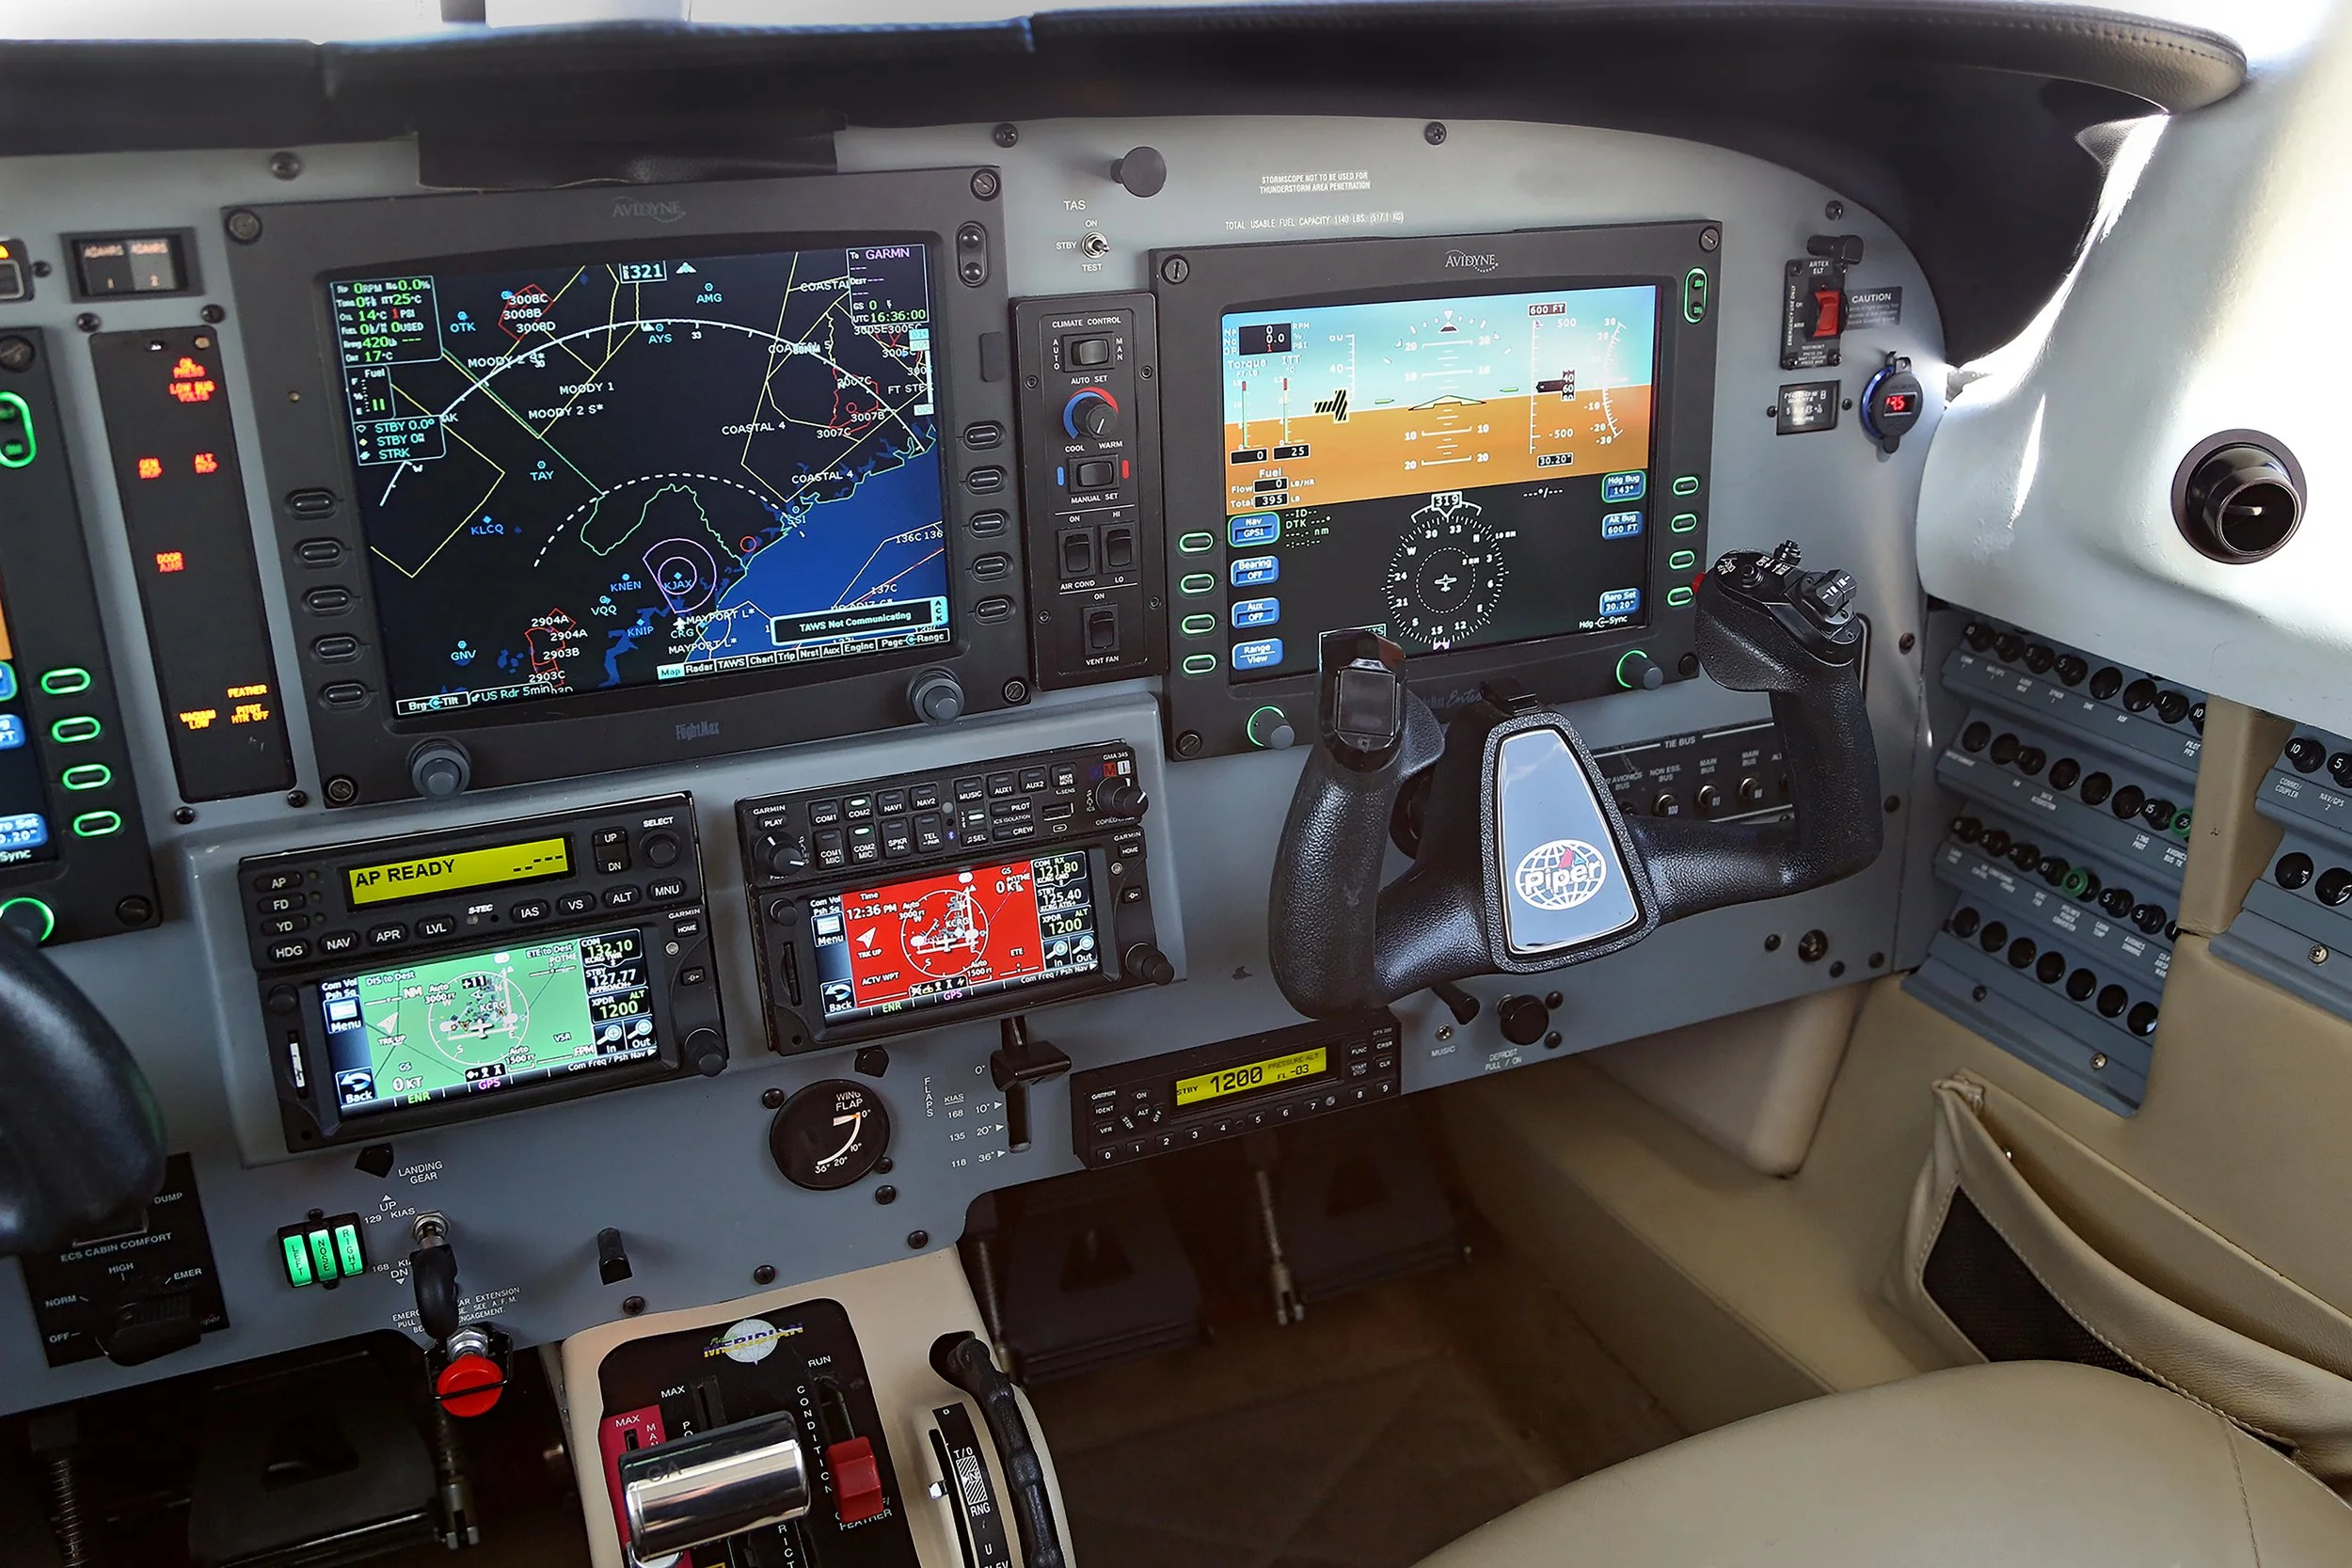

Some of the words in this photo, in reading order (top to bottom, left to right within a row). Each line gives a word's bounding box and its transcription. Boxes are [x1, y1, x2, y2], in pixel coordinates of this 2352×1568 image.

[1262, 174, 1304, 183] STORMSCOPE
[1306, 174, 1317, 182] NOT
[1319, 173, 1327, 182] TO
[1329, 173, 1337, 182] BE
[1338, 172, 1354, 181] USED
[1356, 171, 1367, 180] FOR
[1260, 184, 1311, 194] THUNDERSTORM
[1312, 183, 1328, 192] AREA
[1329, 181, 1371, 190] PENETRATION
[1064, 200, 1086, 211] TAS
[1085, 219, 1097, 228] ON
[1226, 221, 1245, 230] TOTAL
[1251, 219, 1275, 229] USABLE
[1279, 218, 1295, 227] FUEL
[1299, 216, 1329, 226] CAPACITY
[1334, 215, 1348, 224] 1140
[1370, 213, 1389, 223] (517.1
[1393, 211, 1404, 223] KG)
[1056, 241, 1077, 250] STBY
[866, 248, 910, 260] GARMN
[1445, 254, 1496, 268] AVIDYNE
[630, 264, 663, 278] 321
[1082, 263, 1103, 272] TEST
[696, 293, 723, 303] AMG
[1851, 293, 1892, 303] CAUTION
[1530, 305, 1548, 314] 600
[1552, 304, 1564, 312] FT
[871, 309, 926, 323] 16:36:00
[451, 323, 475, 333] OTK
[1052, 319, 1083, 328] CLIMATE
[1088, 317, 1121, 325] CONTROL
[1071, 376, 1089, 385] AUTO
[560, 383, 604, 394] MOODY
[608, 382, 613, 391] 1
[1099, 440, 1123, 450] WARM
[378, 450, 410, 459] STRK
[1292, 447, 1305, 456] 25
[530, 471, 554, 481] TAY
[1260, 468, 1282, 478] Fuel
[1626, 475, 1640, 483] Bug
[1071, 495, 1101, 503] MANUAL
[1262, 496, 1283, 504] 395
[1436, 497, 1458, 506] 319
[1246, 517, 1263, 526] Nav
[470, 524, 504, 535] KLCQ
[1238, 559, 1272, 570] Bearing
[1248, 571, 1263, 579] OFF
[611, 581, 642, 592] KNEN
[1060, 582, 1073, 591] AIR
[591, 605, 617, 616] VQQ
[800, 622, 826, 632] TAWS
[829, 619, 844, 628] Not
[846, 610, 912, 626] Communicating
[660, 667, 681, 677] Map
[685, 662, 713, 673] Radar
[718, 658, 745, 669] TAWS
[750, 655, 773, 665] Chart
[778, 652, 795, 662] Trip
[801, 648, 819, 658] Nrst
[823, 645, 840, 656] Aux
[844, 641, 874, 654] Engine
[1086, 657, 1104, 666] VENT
[228, 684, 267, 699] FEATHER
[1665, 738, 1677, 749] TIE
[1678, 736, 1695, 746] BUS
[2275, 785, 2299, 799] COUPLER
[917, 799, 935, 807] NAV2
[1011, 802, 1030, 811] PILOT
[753, 805, 786, 815] GARMIN
[849, 809, 870, 817] COM2
[644, 816, 674, 828] SELECT
[765, 818, 783, 827] PLAY
[815, 815, 836, 823] COM1
[1013, 827, 1033, 835] CREW
[605, 833, 617, 842] UP
[609, 862, 621, 871] DN
[1040, 862, 1078, 877] 121.80
[355, 873, 381, 887] AP
[388, 859, 455, 882] READY
[1524, 861, 1601, 895] Piper
[271, 878, 286, 889] AP
[655, 884, 679, 896] MNU
[612, 892, 631, 904] ALT
[1042, 889, 1082, 905] 125.40
[274, 900, 289, 911] FD
[521, 907, 539, 917] IAS
[669, 909, 700, 919] GARMIN
[847, 905, 882, 921] 12:36
[883, 904, 898, 913] PM
[426, 923, 447, 934] LVL
[1049, 919, 1082, 935] 1200
[376, 929, 400, 942] APR
[326, 938, 350, 950] NAV
[588, 939, 633, 956] 132.10
[276, 945, 303, 958] HDG
[592, 968, 636, 986] 127.77
[943, 990, 962, 1001] GPS
[829, 1001, 852, 1012] Back
[1376, 1041, 1392, 1050] CRSR
[1431, 1046, 1455, 1057] MUSIC
[1290, 1065, 1310, 1076] -03
[1176, 1085, 1198, 1096] STBY
[1210, 1067, 1263, 1094] 1200
[835, 1091, 861, 1101] WING
[924, 1077, 933, 1117] FLAPS
[945, 1094, 964, 1103] KIAS
[1136, 1091, 1147, 1100] ON
[835, 1099, 863, 1111] FLAP
[947, 1110, 963, 1119] 168
[949, 1132, 965, 1141] 135
[398, 1161, 442, 1177] LANDING
[410, 1172, 437, 1184] GEAR
[154, 1193, 183, 1204] DUMP
[379, 1201, 396, 1212] UP
[364, 1214, 381, 1224] 129
[390, 1208, 415, 1218] KIAS
[60, 1252, 82, 1261] ECS
[85, 1243, 118, 1257] CABIN
[120, 1233, 172, 1249] COMFORT
[342, 1229, 356, 1270] RIGHT
[291, 1244, 304, 1276] LEFT
[318, 1240, 329, 1271] NOSE
[108, 1262, 134, 1274] HIGH
[174, 1268, 201, 1280] EMER
[475, 1287, 520, 1302] EXTENSION
[45, 1295, 76, 1307] NORM
[49, 1333, 70, 1343] OFF
[808, 1355, 832, 1368] RUN
[661, 1385, 686, 1399] MAX
[953, 1447, 973, 1458] T/O
[970, 1502, 991, 1517] RNG
